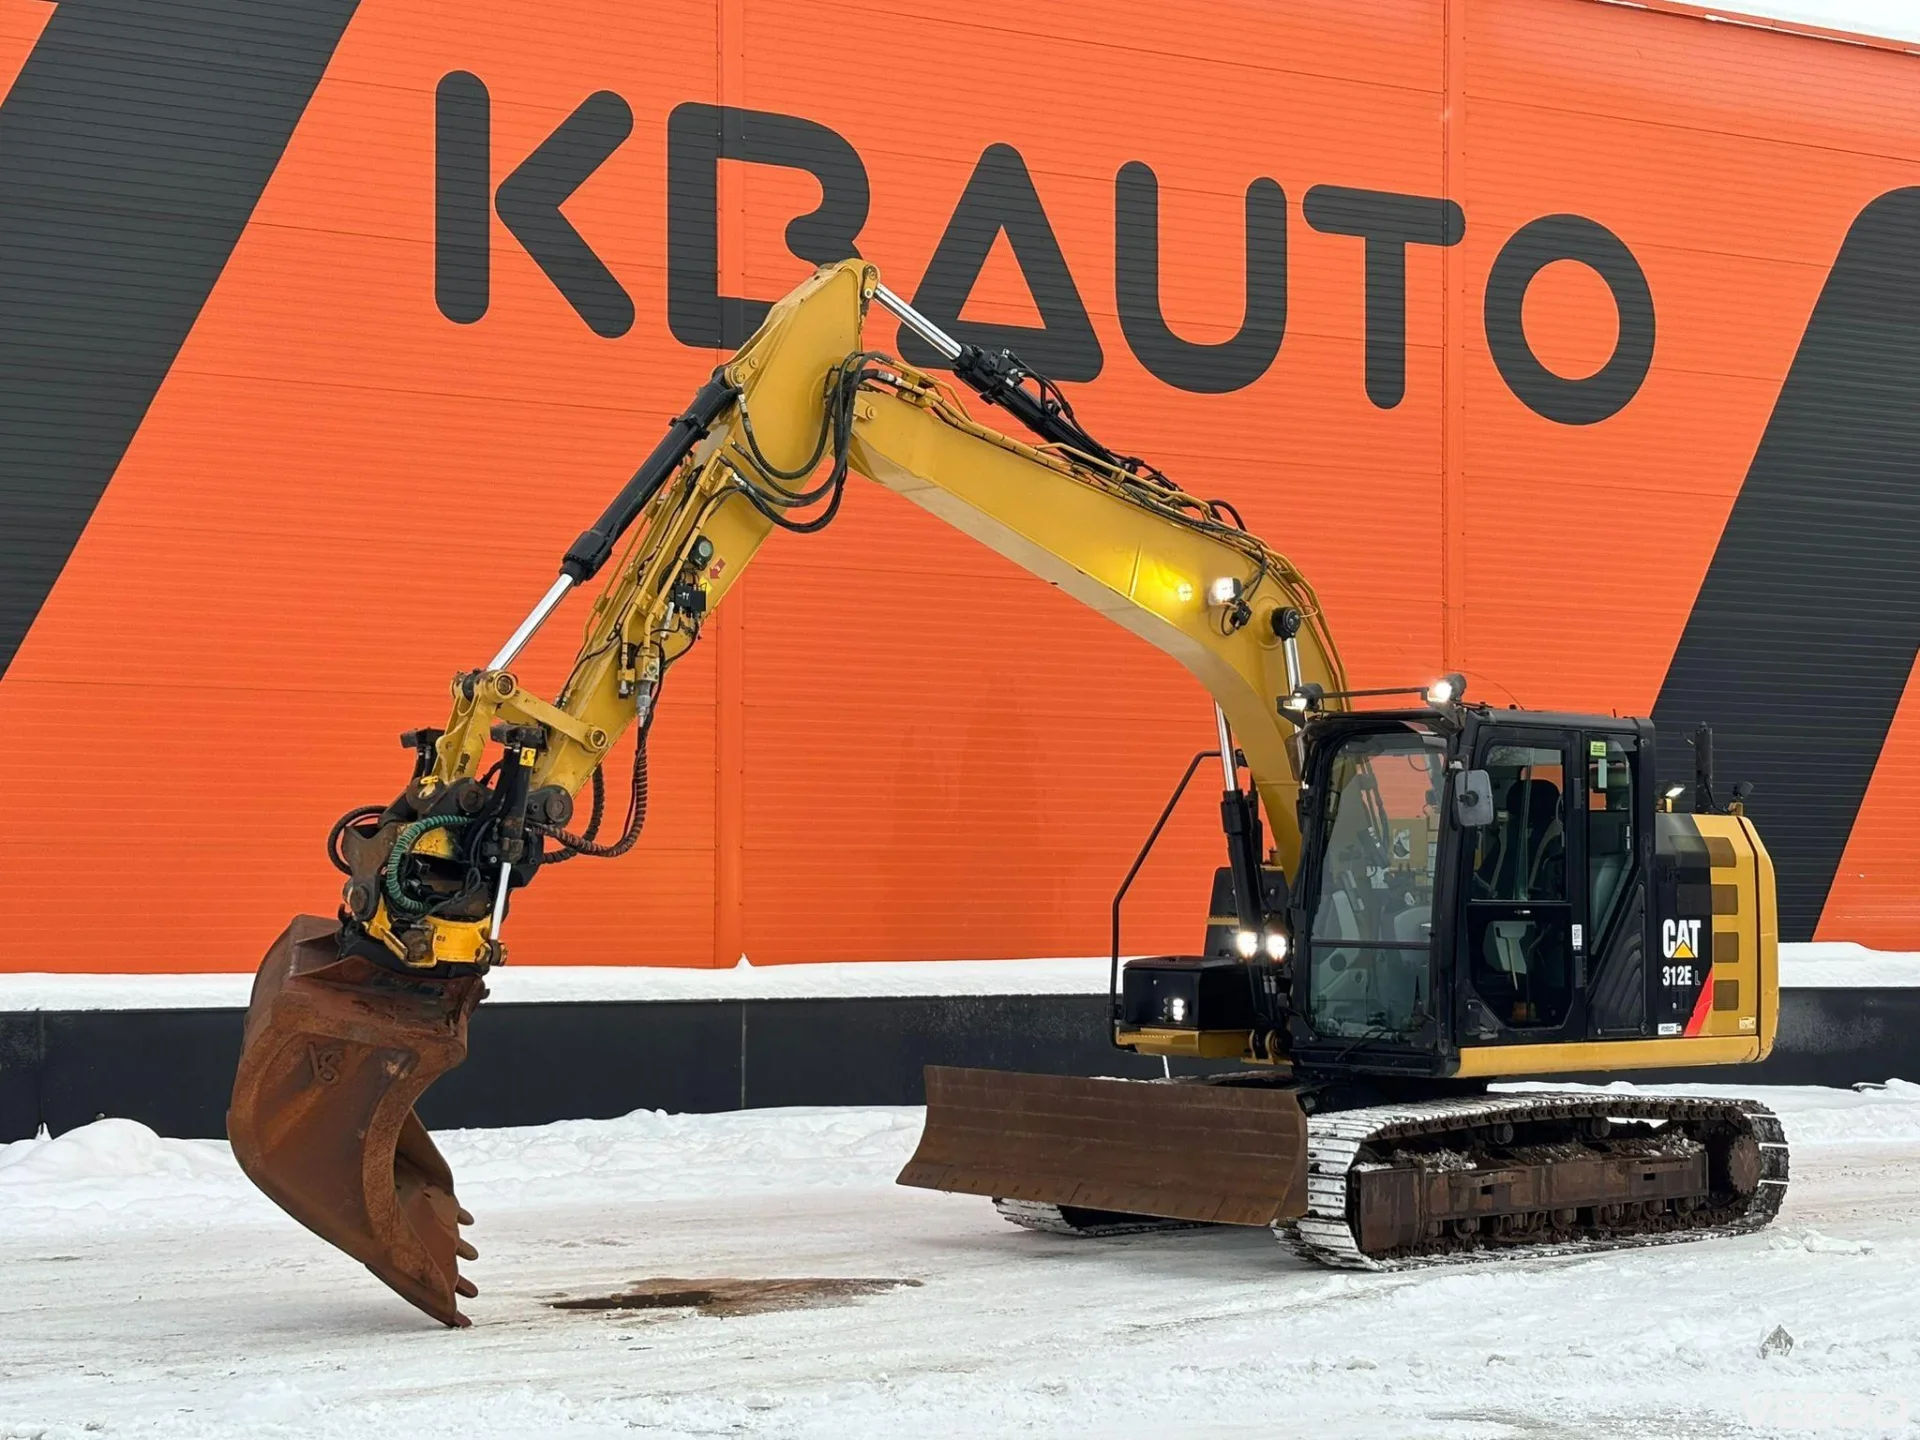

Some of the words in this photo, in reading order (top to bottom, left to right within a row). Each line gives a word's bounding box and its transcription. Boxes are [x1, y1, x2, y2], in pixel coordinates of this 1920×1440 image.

[435, 71, 1656, 424] KRAUTO
[1662, 919, 1701, 958] CAT
[1662, 965, 1692, 986] 312E
